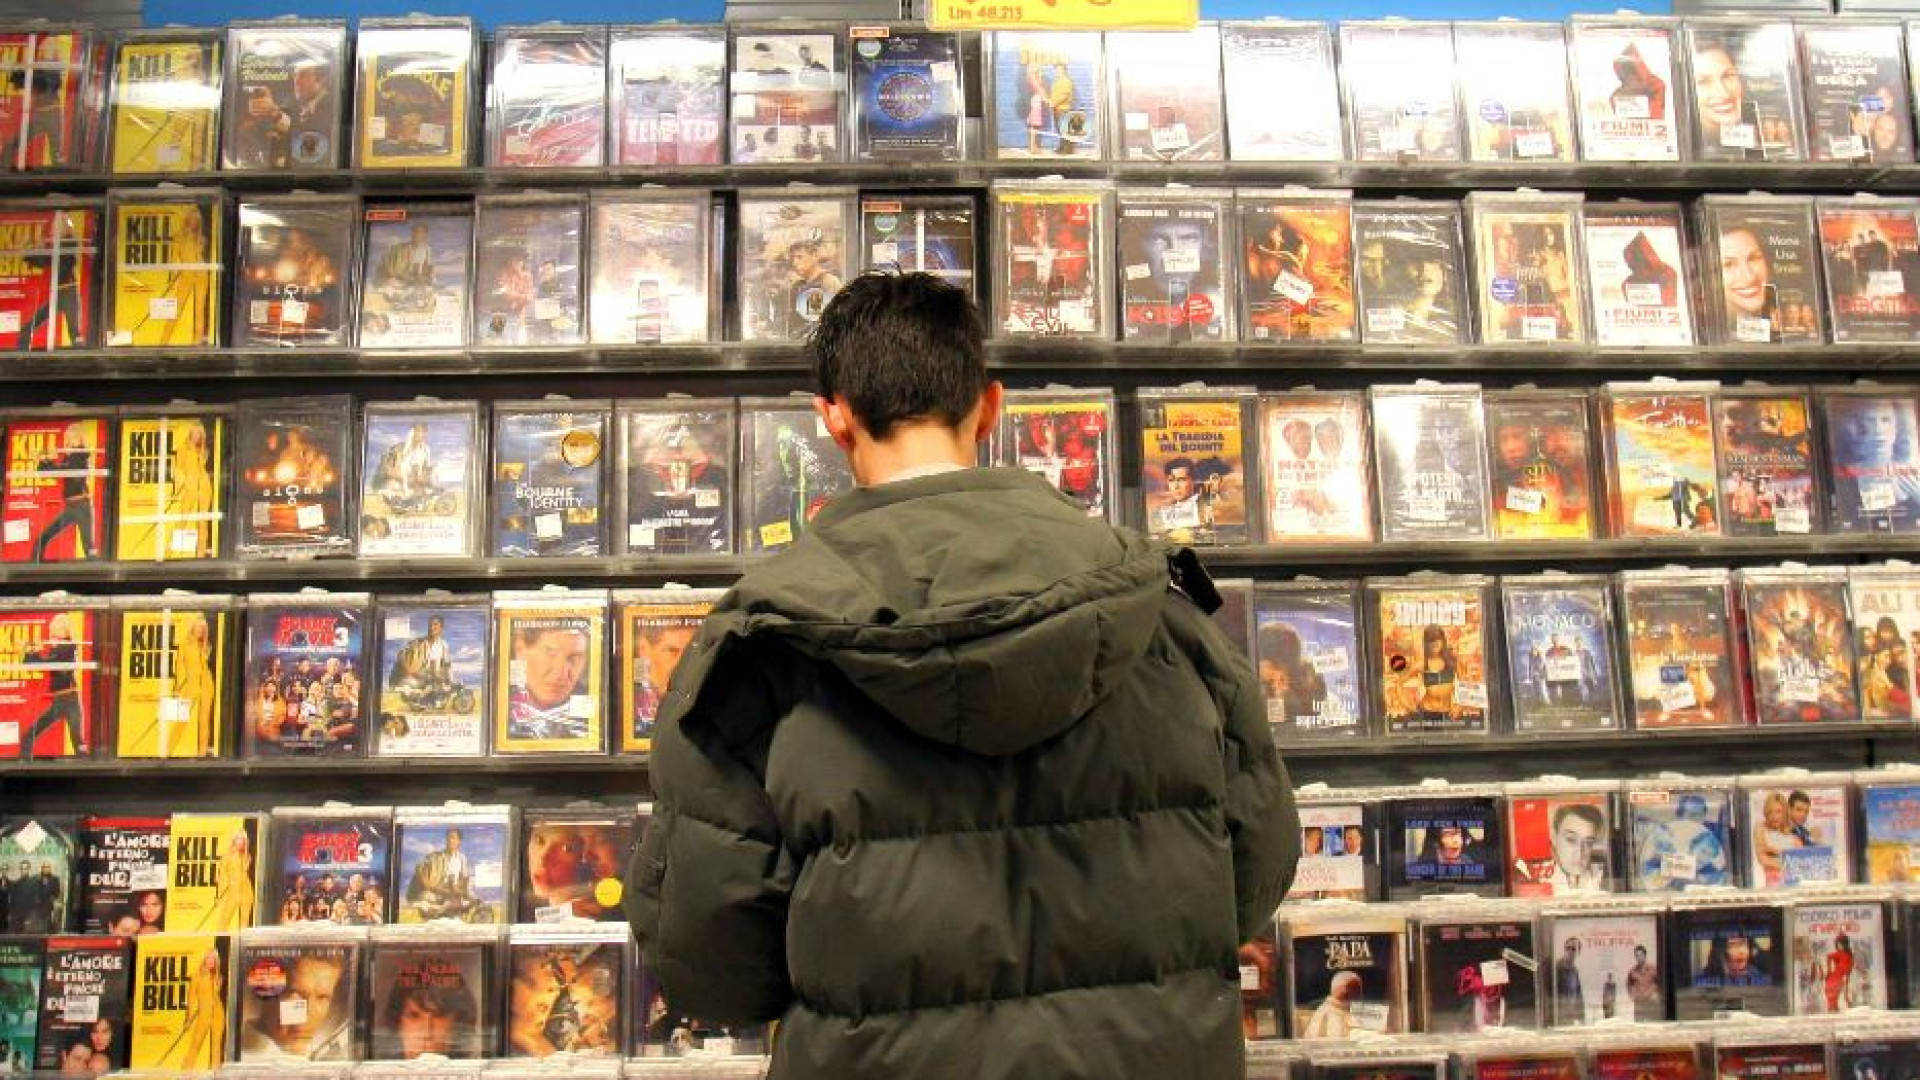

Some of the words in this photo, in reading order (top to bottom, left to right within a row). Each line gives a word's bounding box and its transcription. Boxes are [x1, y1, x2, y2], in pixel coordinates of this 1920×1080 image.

[127, 216, 173, 241] KILL
[1769, 236, 1799, 247] Mona
[1776, 249, 1797, 261] Lisa
[130, 432, 177, 456] KILL
[129, 458, 174, 483] BILL
[515, 485, 576, 499] BOURNE
[530, 498, 583, 509] IDENTITY
[132, 626, 178, 652] KILL
[335, 627, 349, 647] 3
[130, 653, 176, 680] BILL
[177, 839, 221, 862] KILL
[357, 844, 373, 863] 3
[90, 872, 131, 888] DUR
[175, 863, 218, 889] BILL
[1330, 942, 1371, 958] PAPA
[61, 954, 123, 970] L'AMORE
[143, 956, 190, 982] KILL
[142, 984, 187, 1011] BILL
